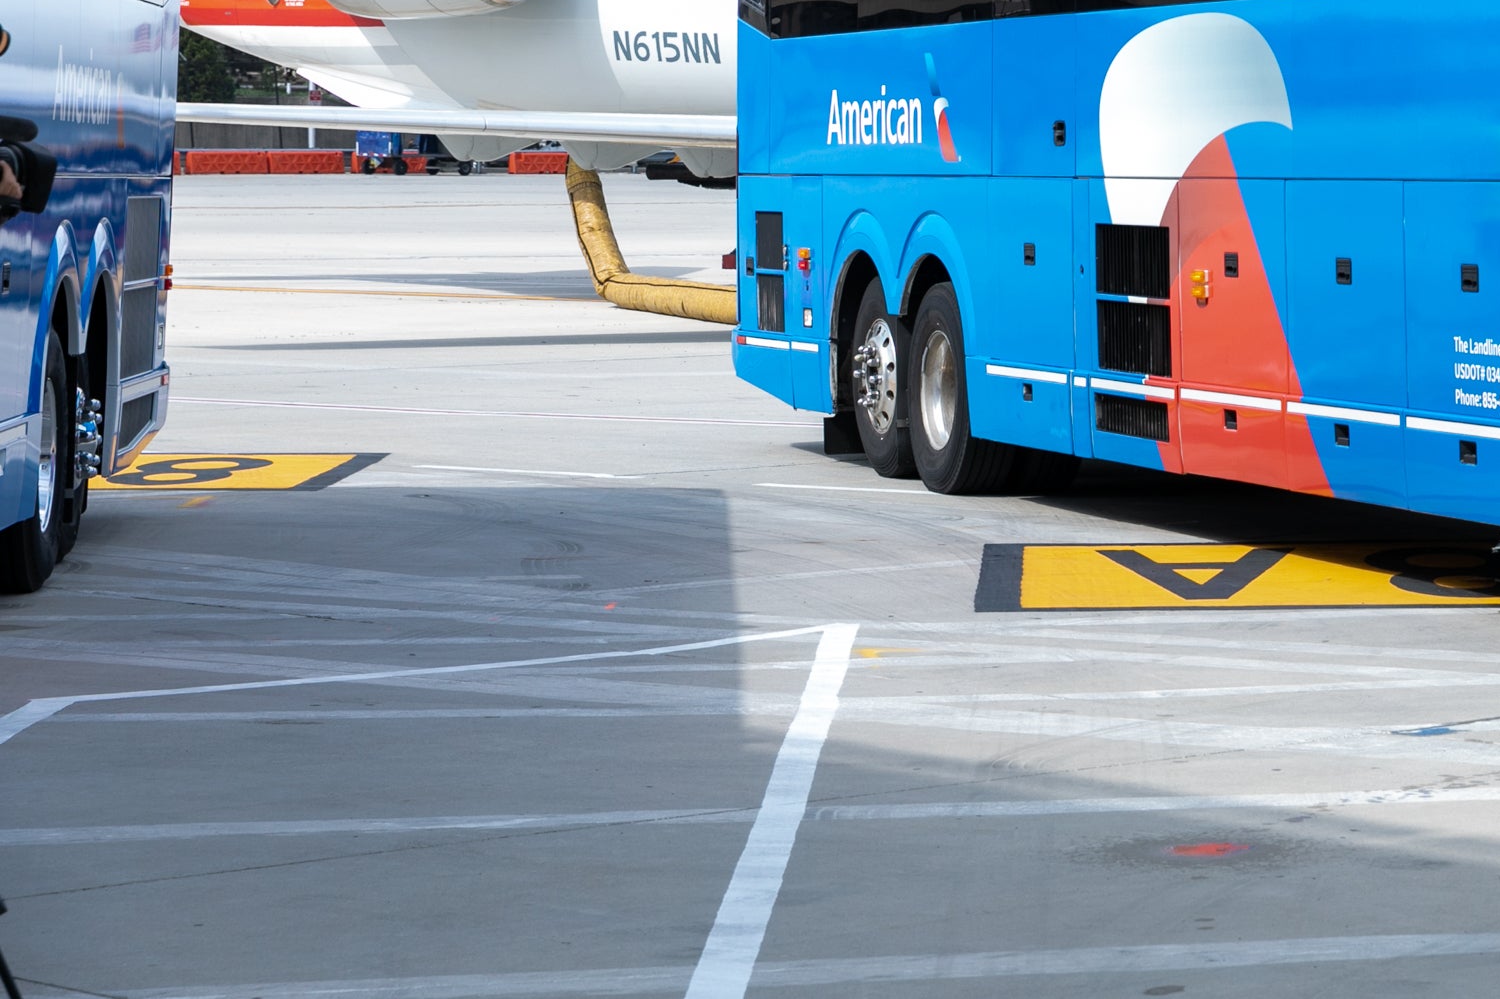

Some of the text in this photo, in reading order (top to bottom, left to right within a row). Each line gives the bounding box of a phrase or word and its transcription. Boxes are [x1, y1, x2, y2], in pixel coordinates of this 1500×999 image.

[613, 30, 721, 64] N615NN
[52, 44, 111, 125] American
[826, 84, 922, 146] American
[1453, 336, 1468, 353] The
[1454, 363, 1485, 381] USDOT#
[1455, 388, 1482, 407] Phone:
